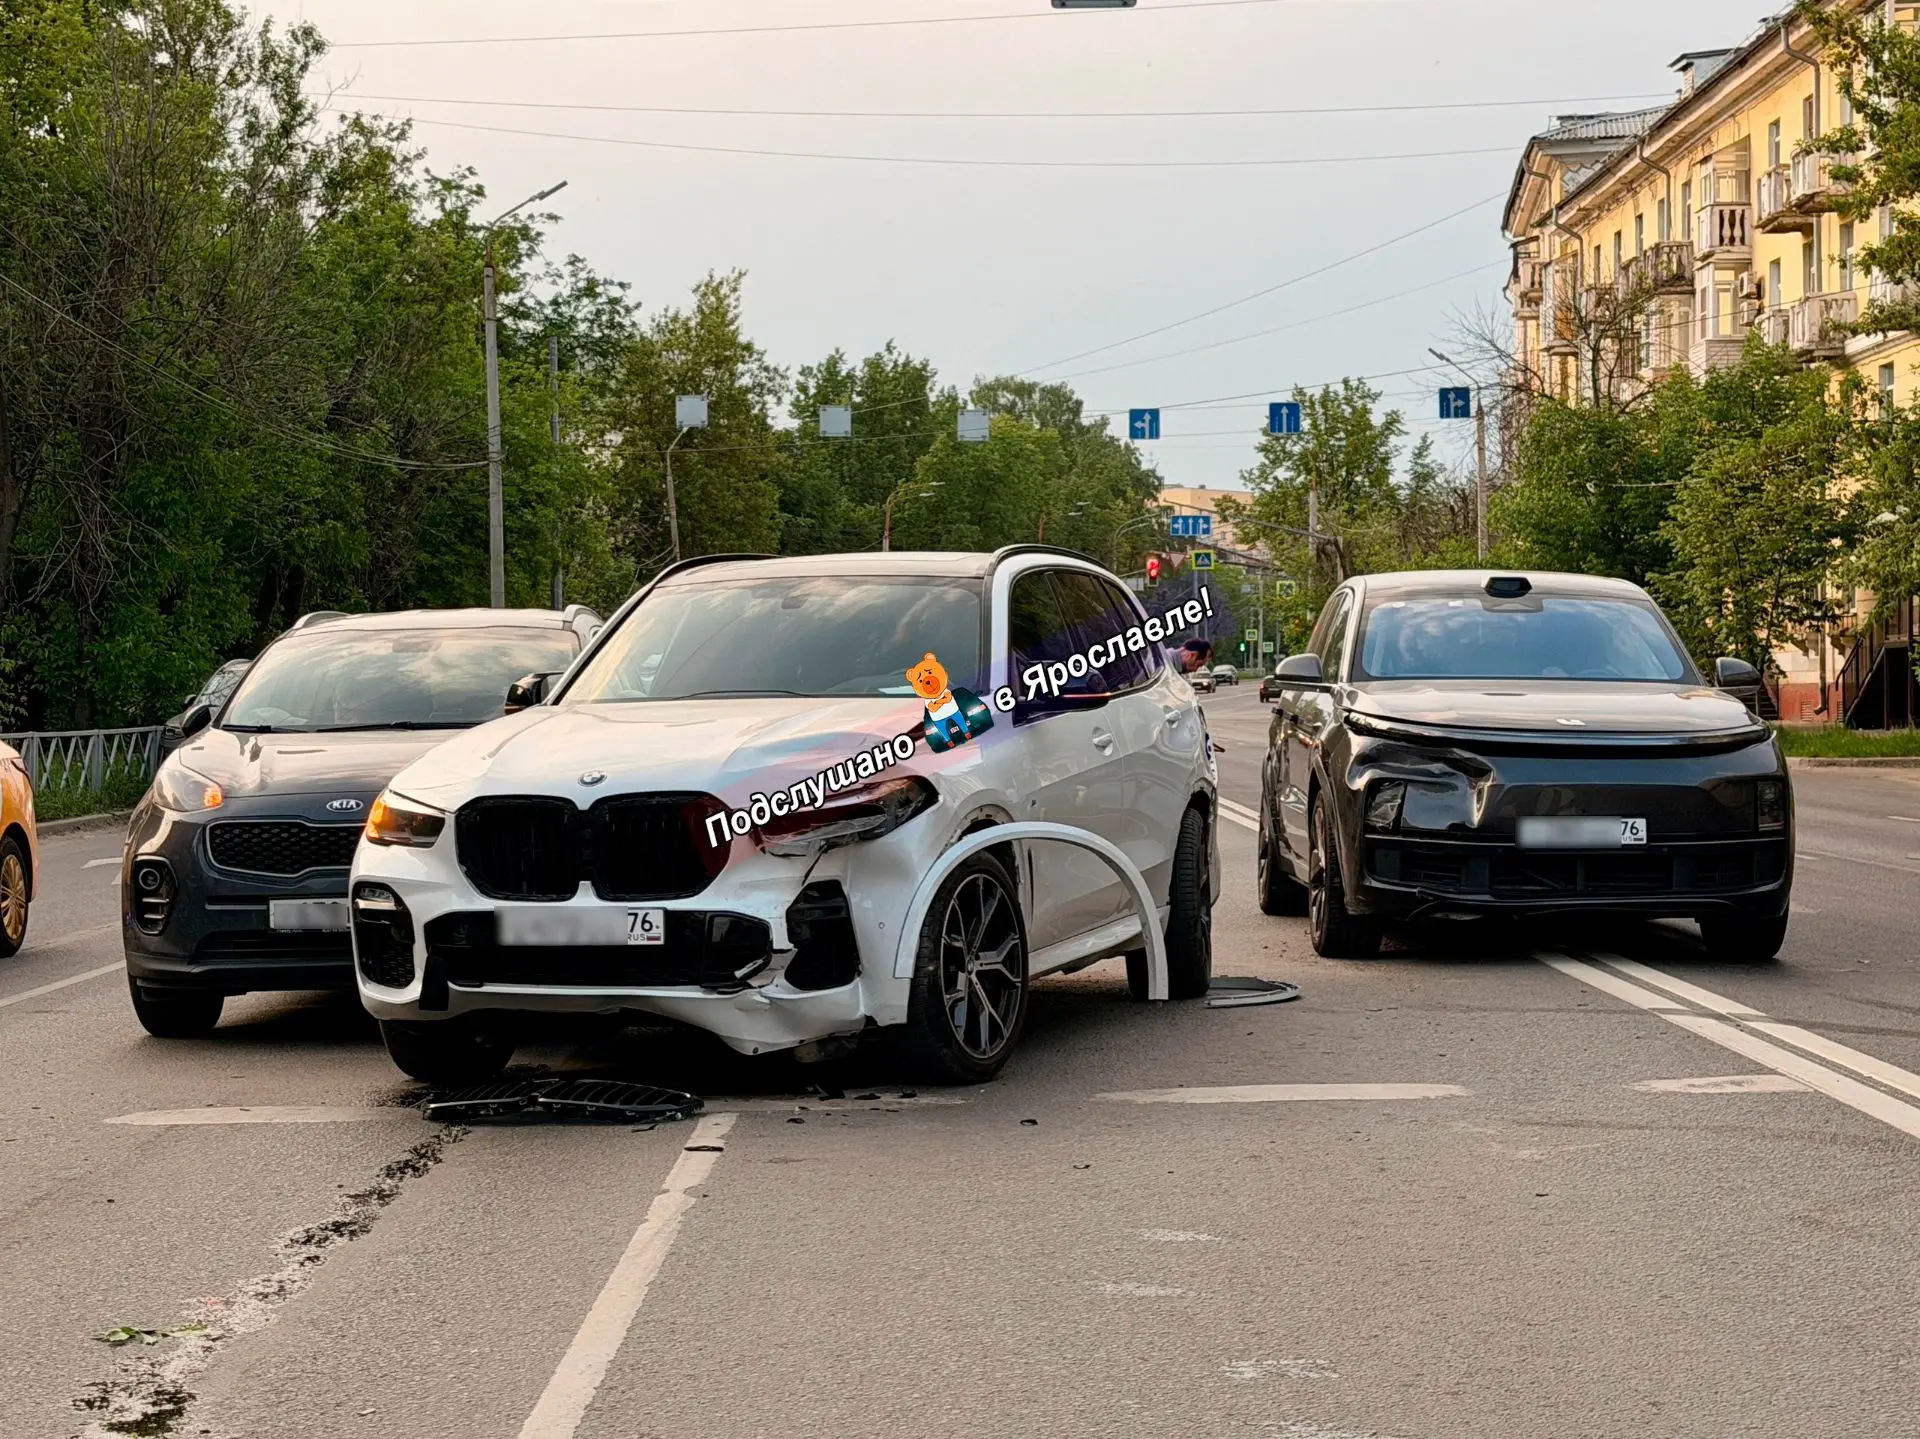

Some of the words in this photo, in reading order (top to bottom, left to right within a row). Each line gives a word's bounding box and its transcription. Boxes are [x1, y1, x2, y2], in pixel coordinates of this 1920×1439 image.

[332, 800, 357, 809] KIA
[1621, 821, 1640, 836] 76
[628, 912, 653, 933] 76
